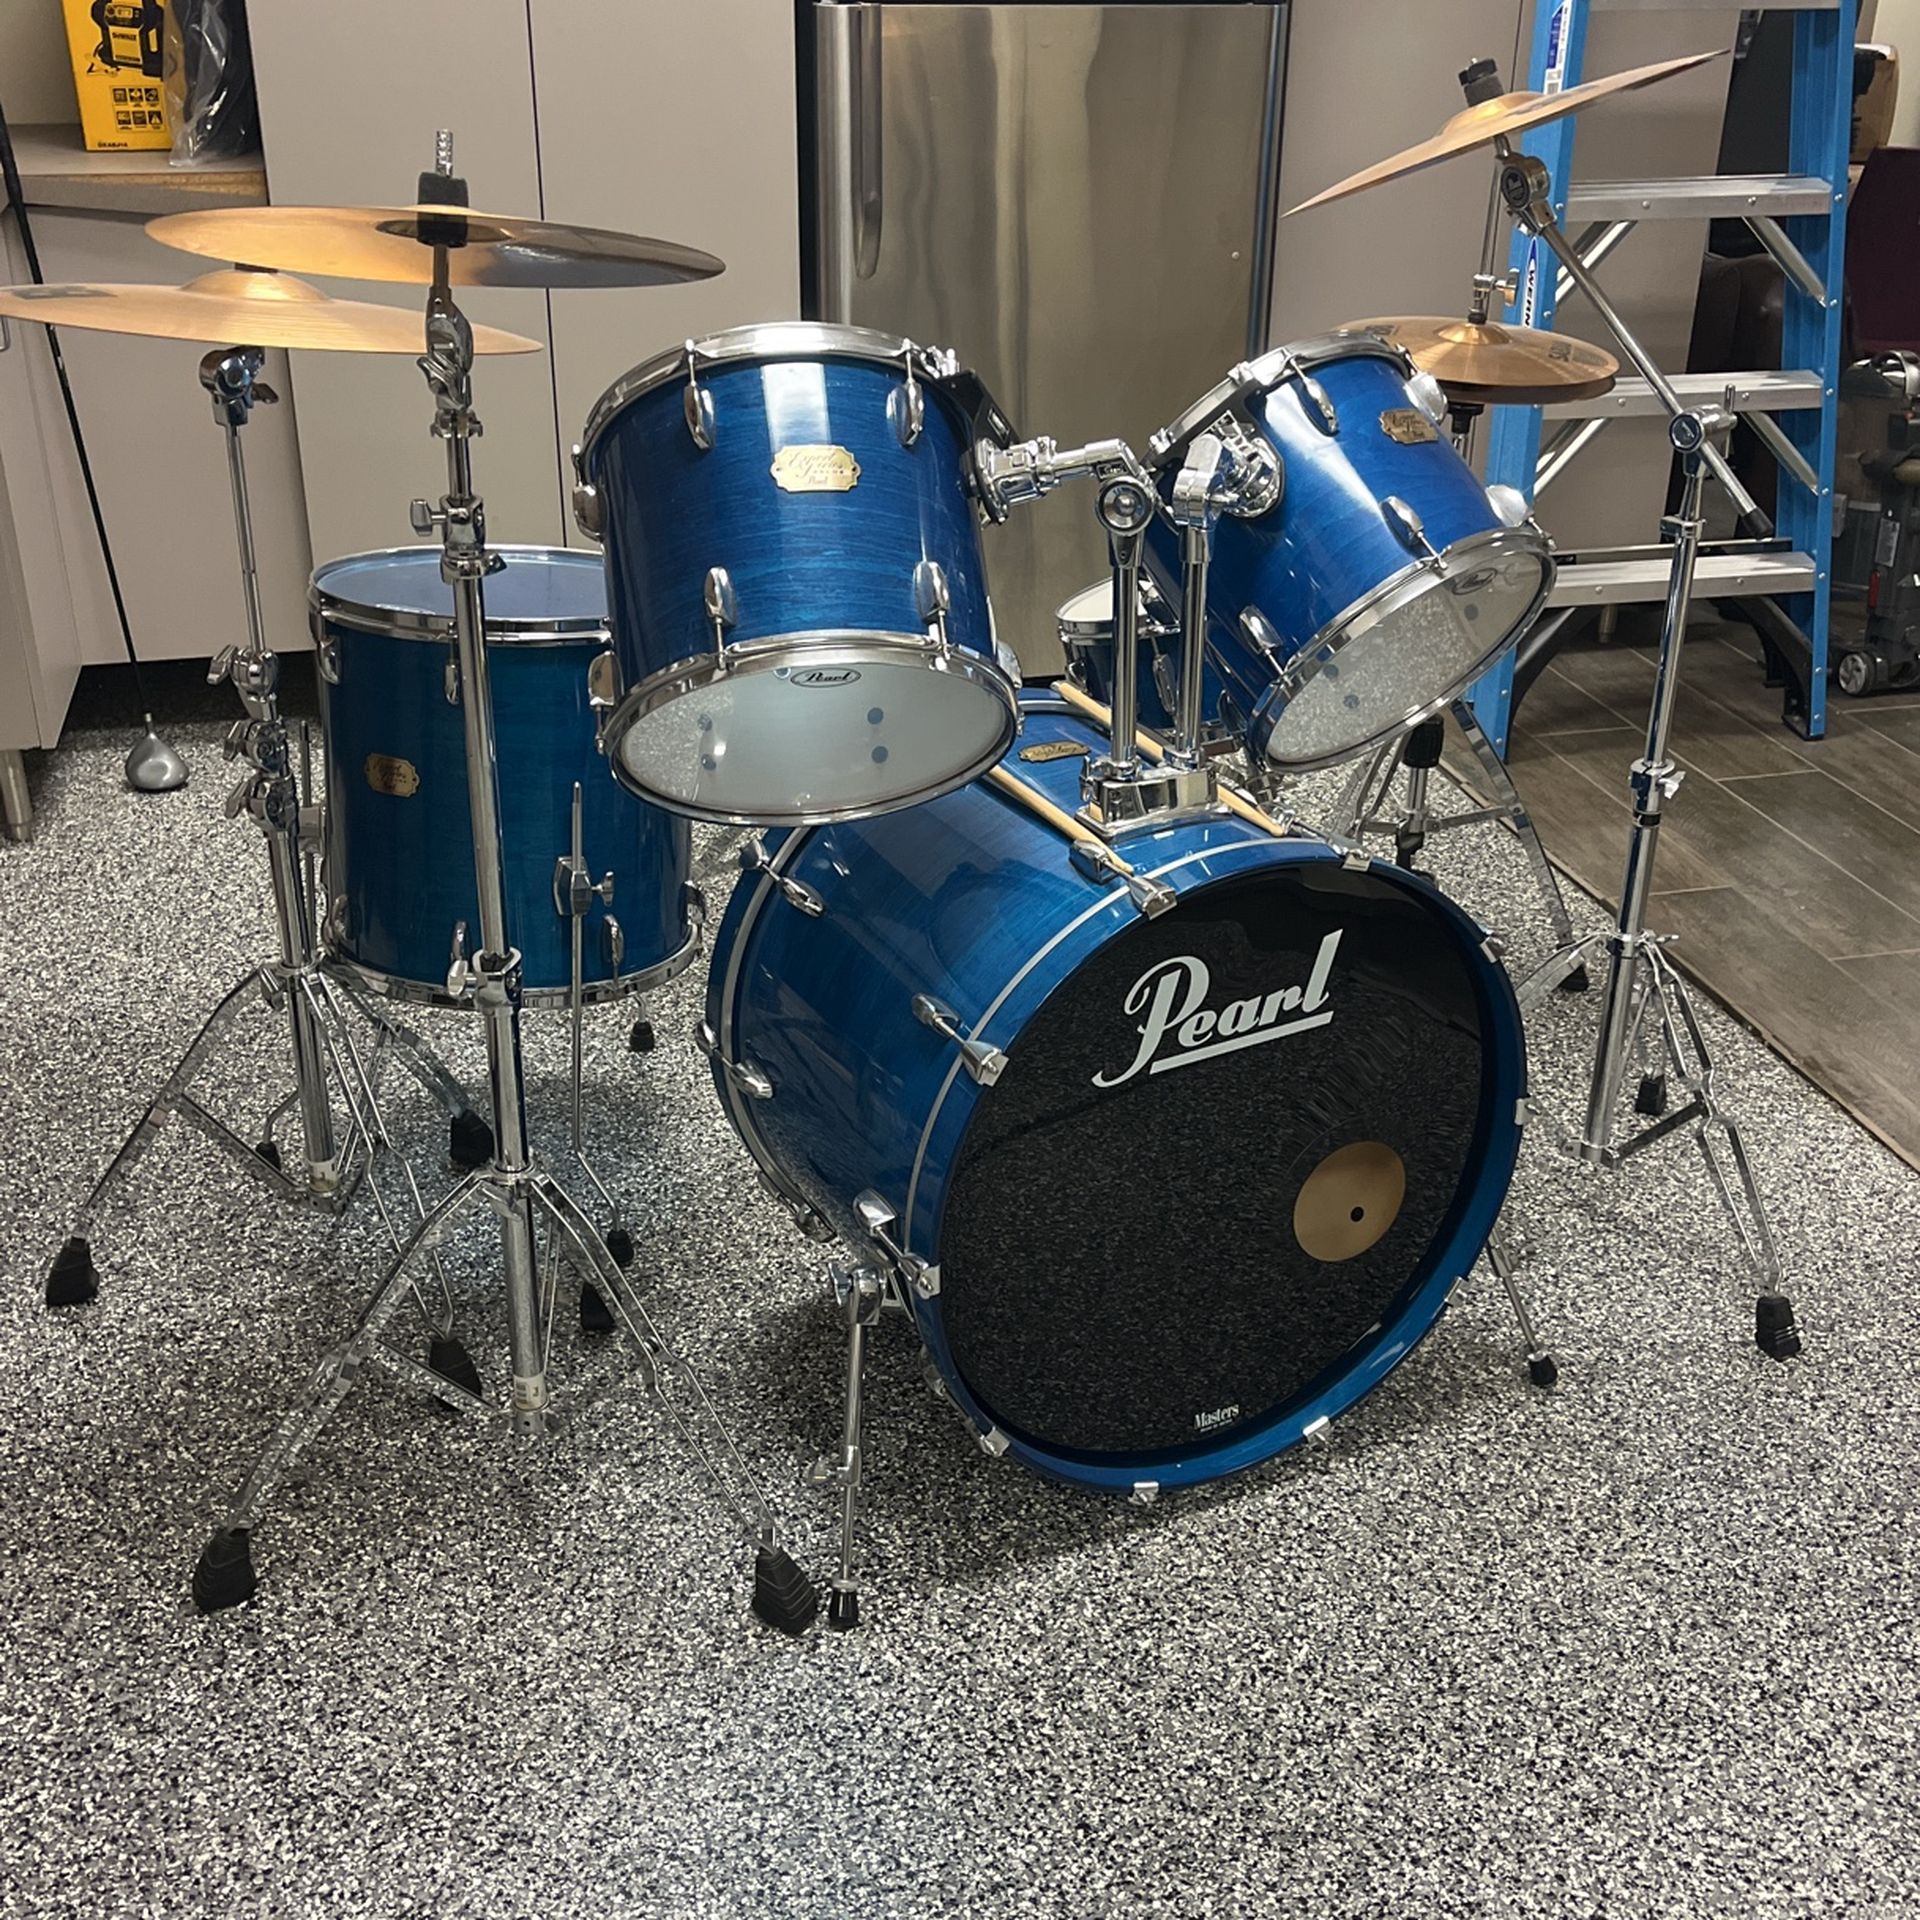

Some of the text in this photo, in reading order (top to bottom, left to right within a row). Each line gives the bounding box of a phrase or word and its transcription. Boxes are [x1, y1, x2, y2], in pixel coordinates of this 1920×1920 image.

[1525, 270, 1535, 327] WERN
[803, 671, 852, 683] Pearl
[1091, 928, 1344, 1088] Pearl
[1195, 1404, 1239, 1430] Masters
